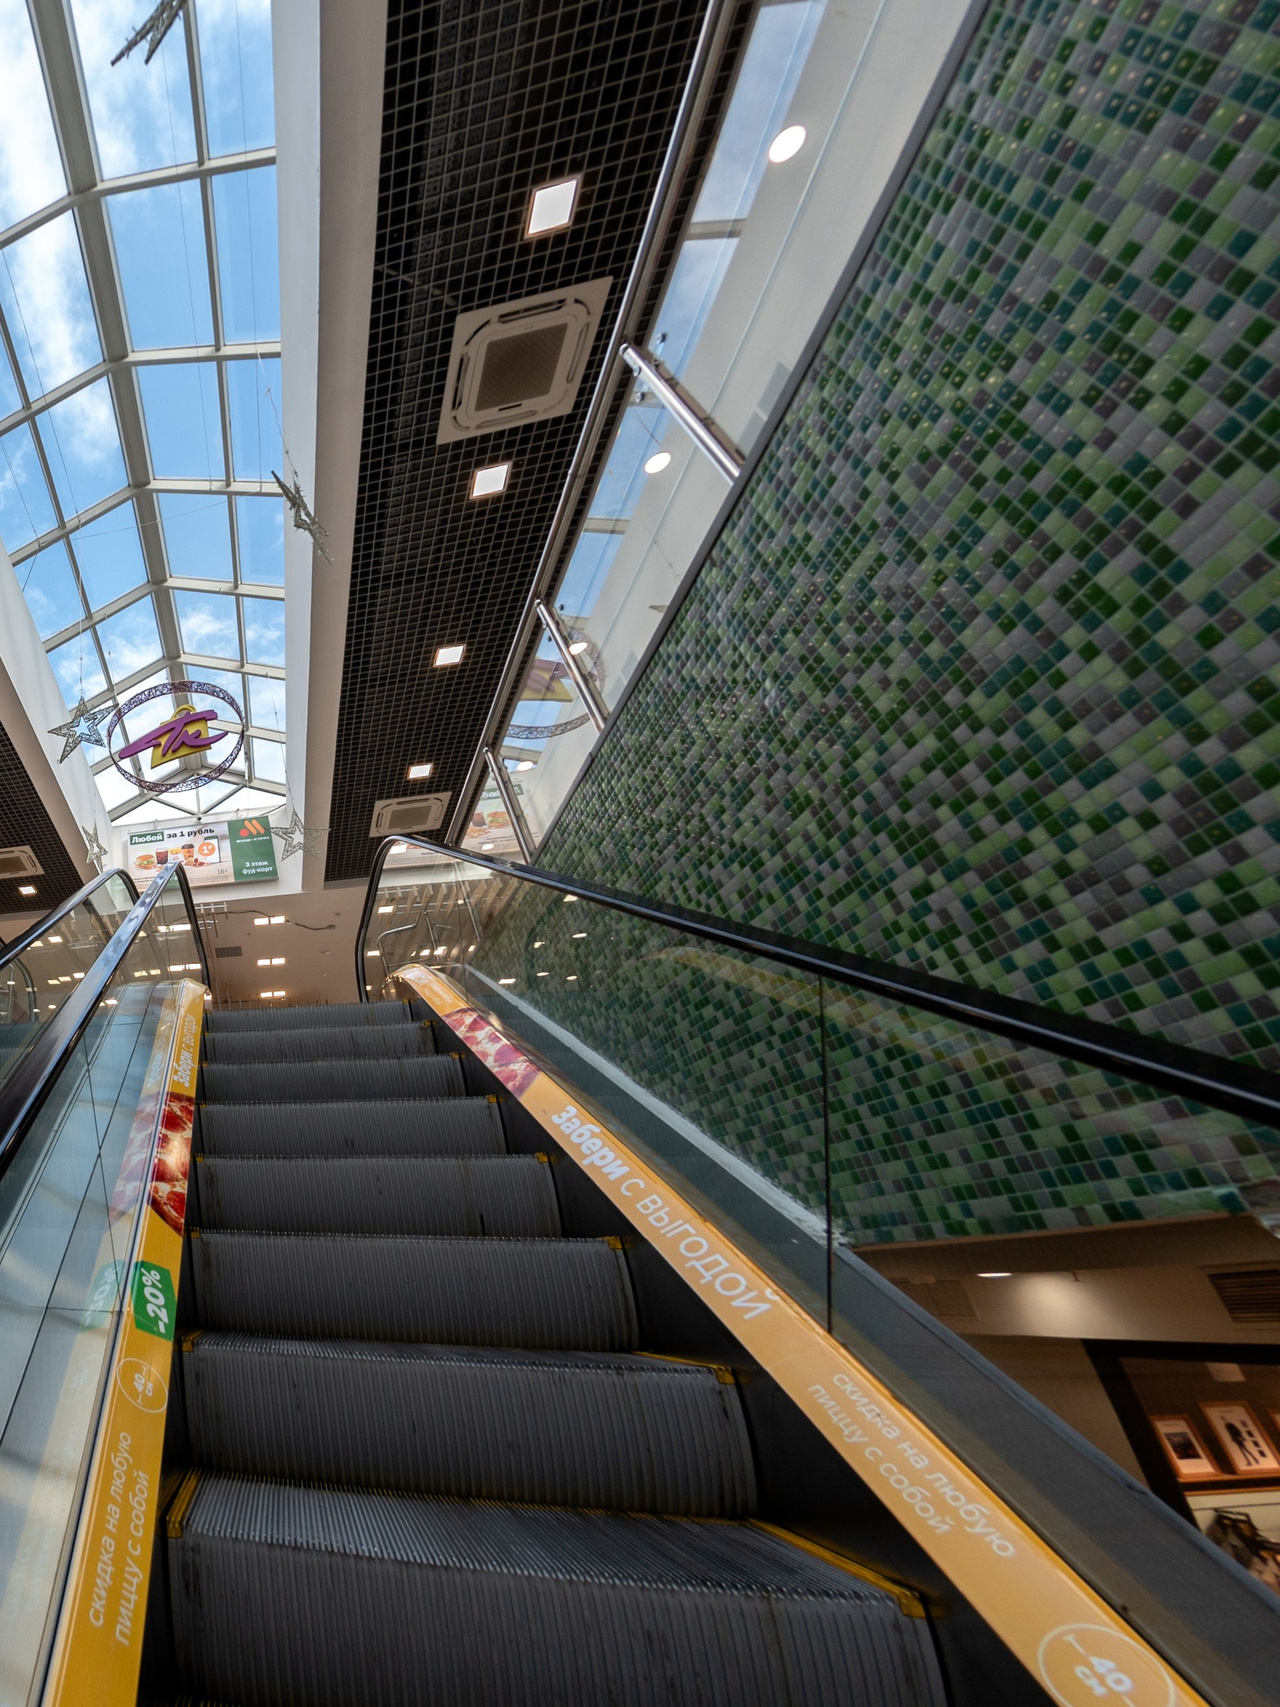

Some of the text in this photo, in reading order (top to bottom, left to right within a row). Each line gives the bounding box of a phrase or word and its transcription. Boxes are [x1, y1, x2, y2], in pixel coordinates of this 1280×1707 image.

[131, 833, 163, 844] Любой
[187, 828, 215, 837] рубль
[173, 1049, 197, 1087] Забери
[551, 1105, 630, 1181] Забери
[621, 1178, 645, 1196] с
[140, 1267, 169, 1334] -20%
[133, 1373, 146, 1392] 40
[807, 1384, 956, 1535] пиццу с собой
[833, 1374, 1015, 1557] скидка на любую
[89, 1431, 132, 1628] скидка на любую
[115, 1469, 150, 1647] пиццу с собой
[1088, 1655, 1133, 1693] 40
